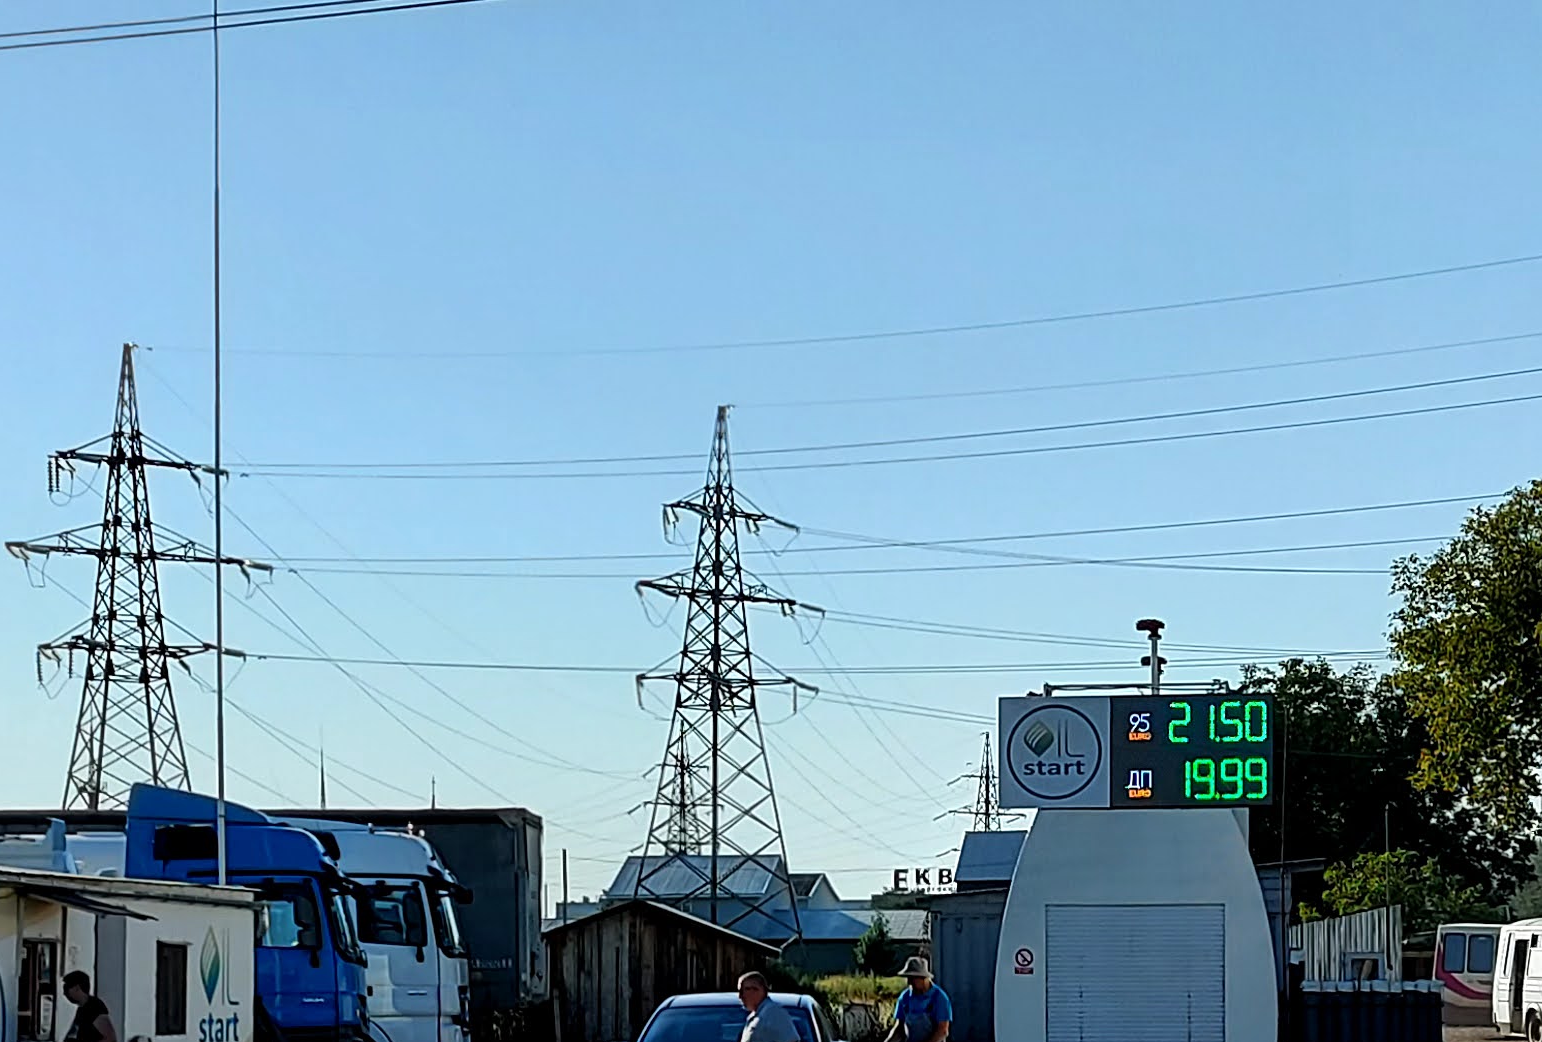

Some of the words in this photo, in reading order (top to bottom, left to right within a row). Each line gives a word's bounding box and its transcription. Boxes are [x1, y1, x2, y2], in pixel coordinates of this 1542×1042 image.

[1129, 713, 1151, 732] 95
[1168, 701, 1267, 742] 21.50
[1023, 761, 1085, 775] start
[1128, 770, 1152, 789] ДП
[1185, 758, 1267, 799] 19.99
